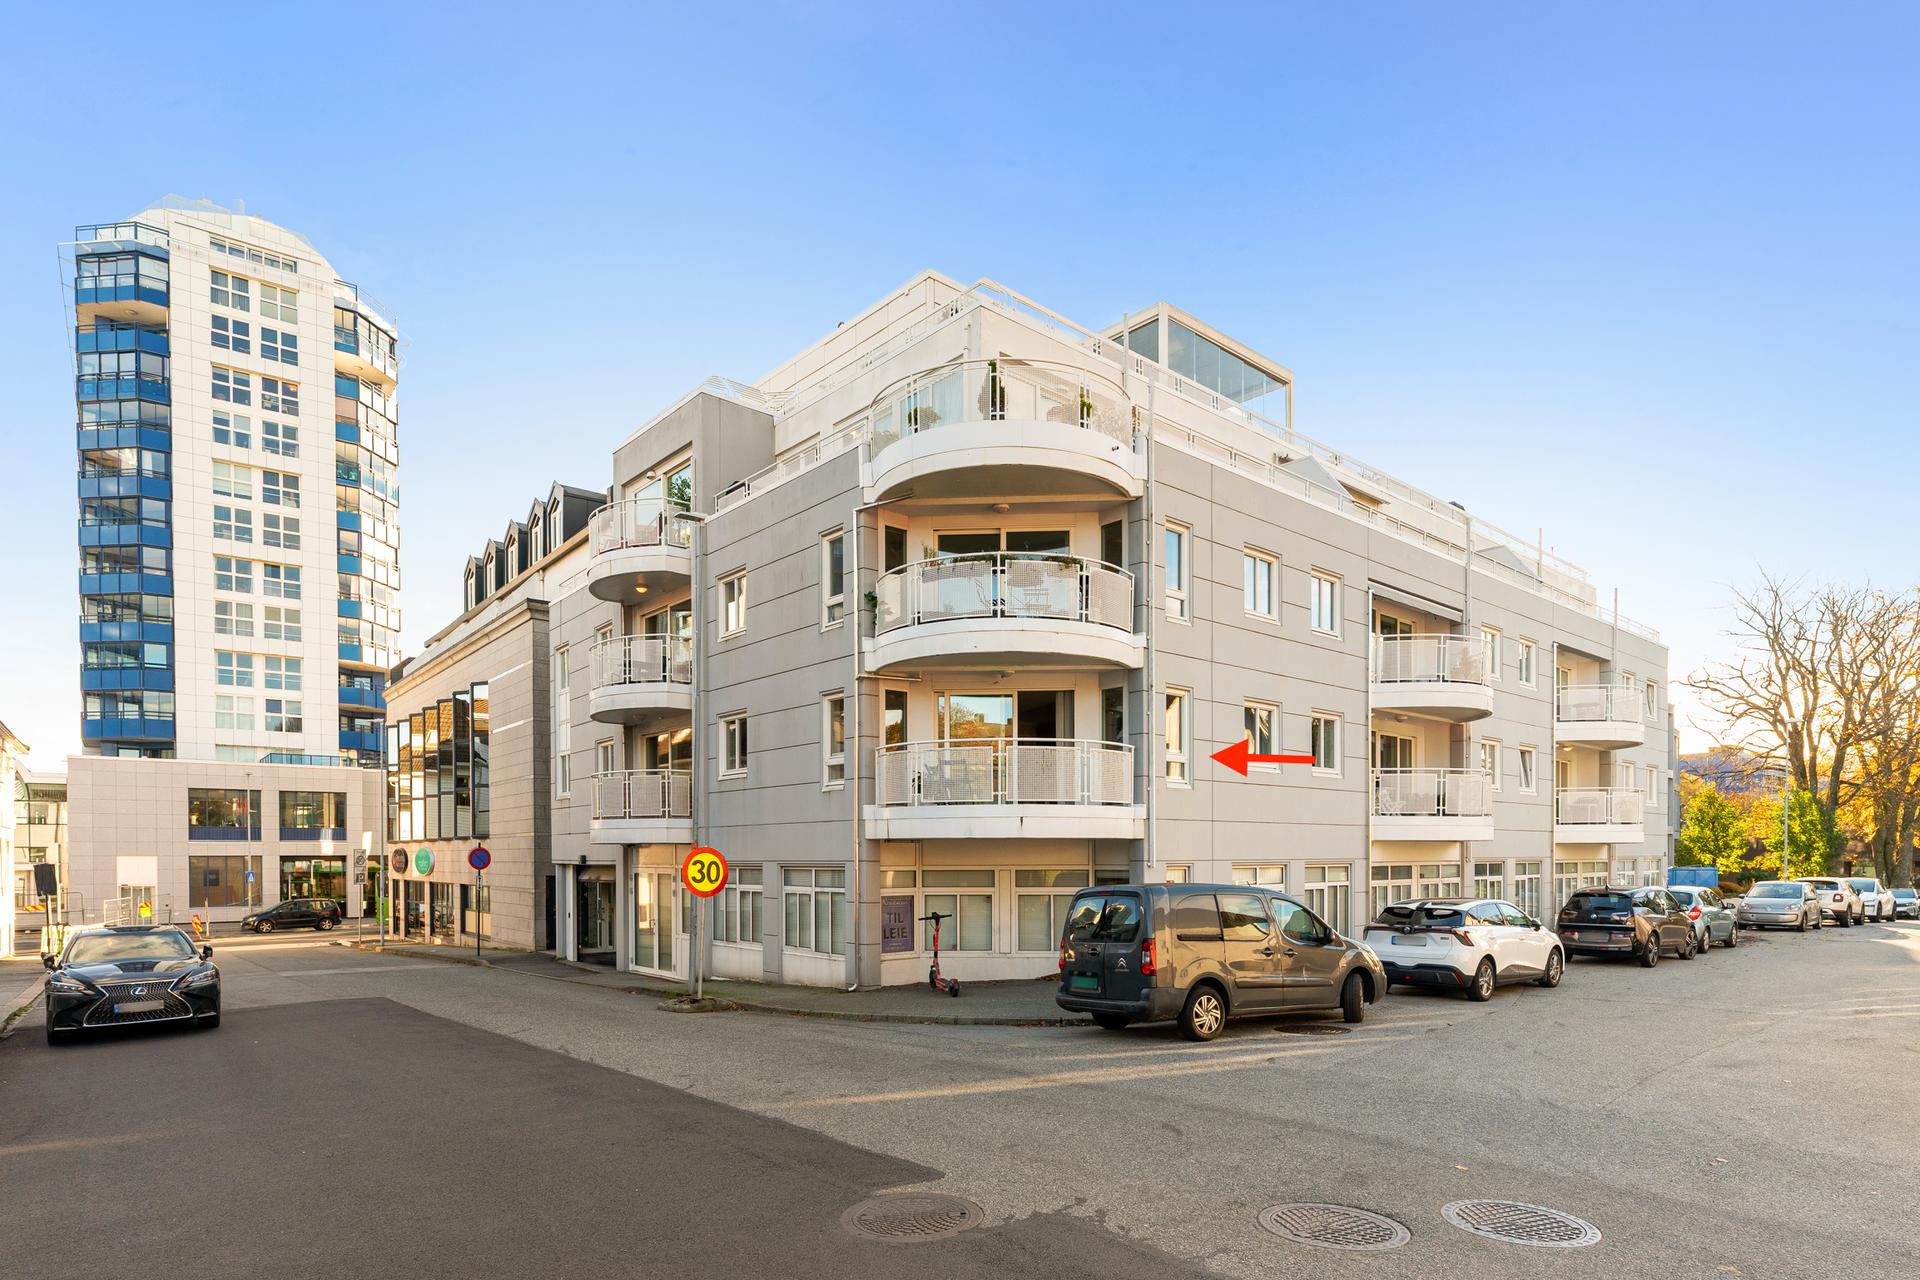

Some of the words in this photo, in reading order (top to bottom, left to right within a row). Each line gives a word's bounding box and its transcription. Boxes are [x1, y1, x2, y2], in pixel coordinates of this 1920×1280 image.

[691, 860, 720, 884] 30
[887, 912, 904, 923] TIL
[883, 927, 908, 939] LEIE
